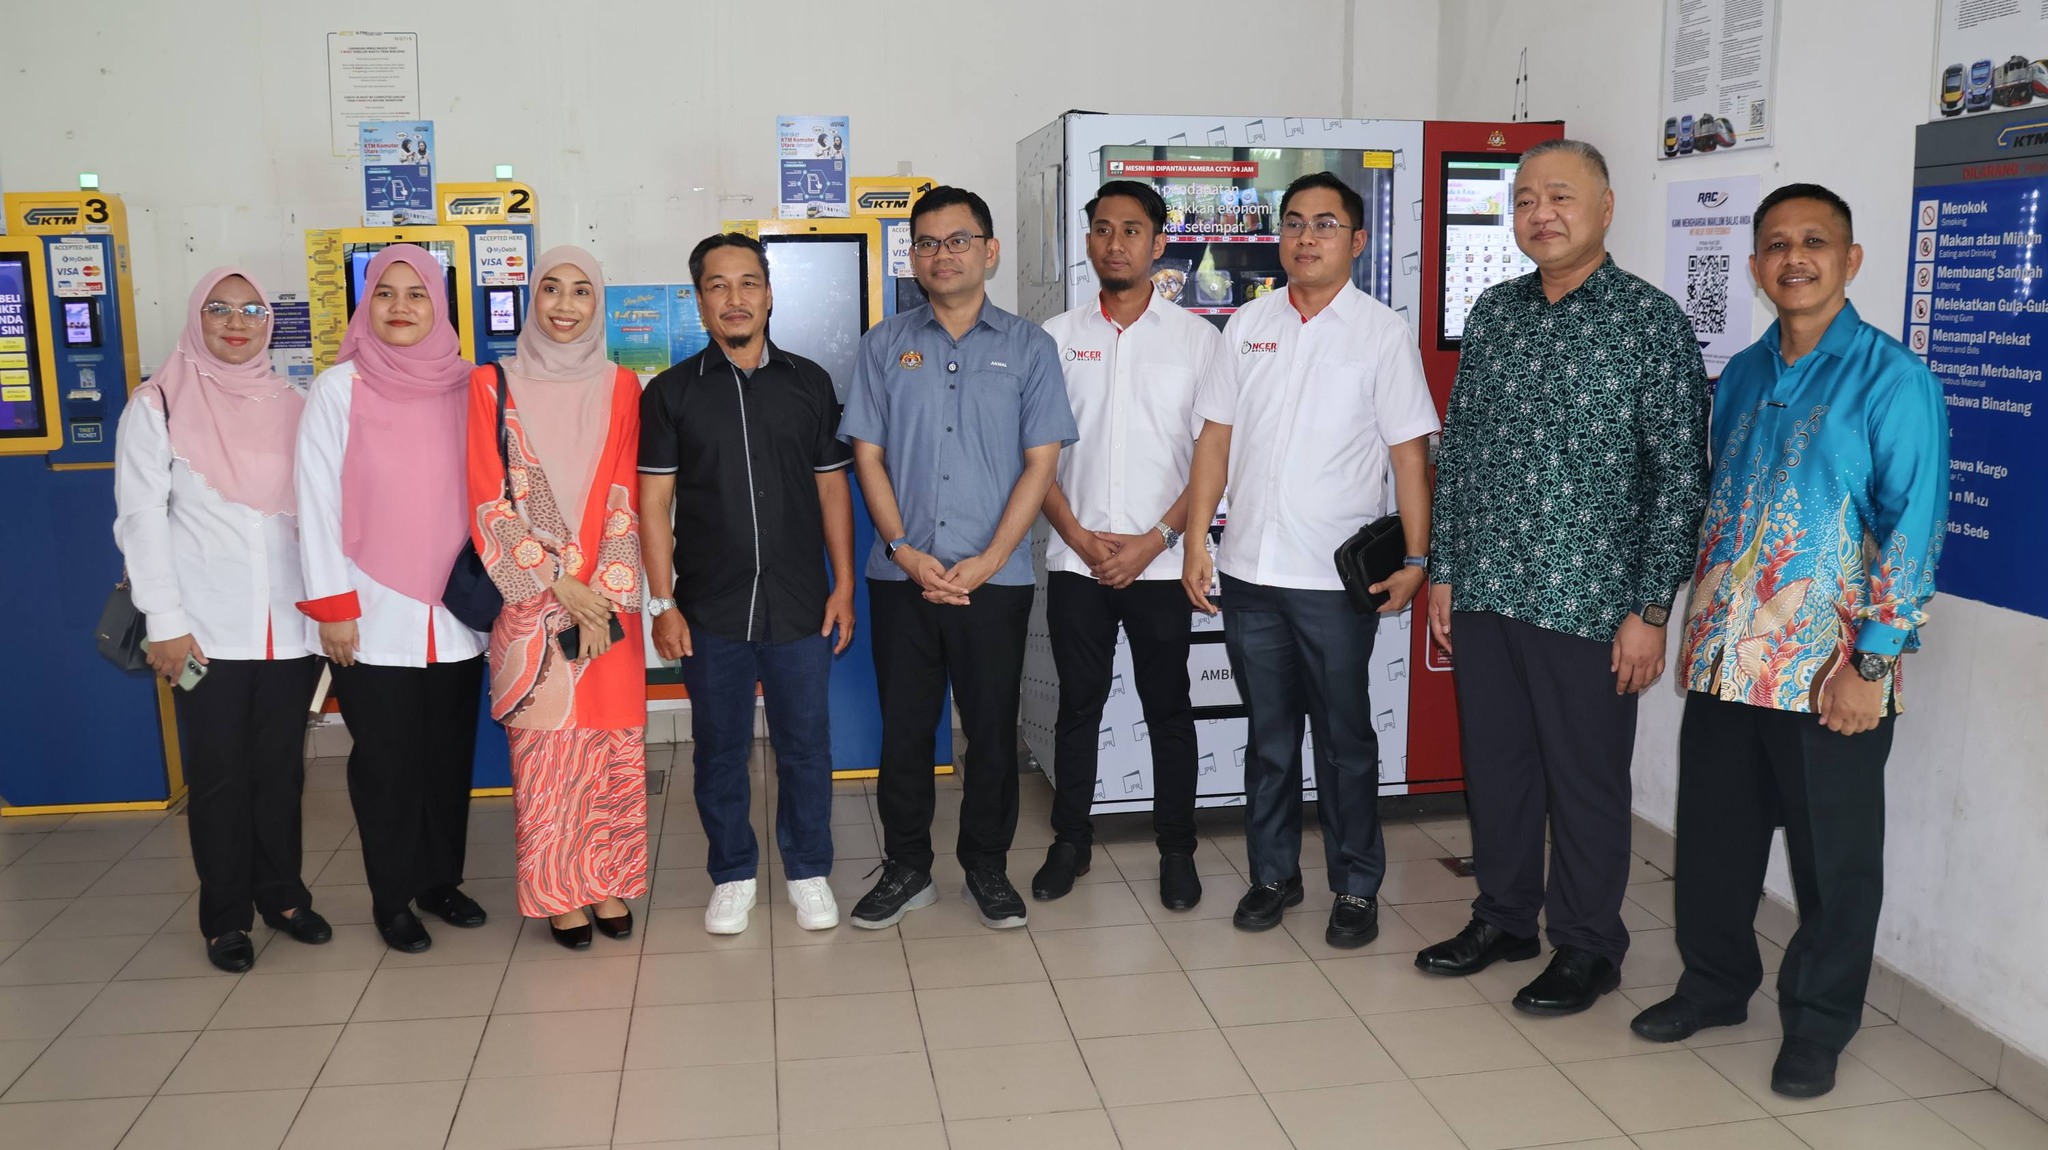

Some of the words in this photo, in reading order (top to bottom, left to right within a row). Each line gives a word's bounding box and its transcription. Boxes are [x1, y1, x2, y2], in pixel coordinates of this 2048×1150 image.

[2013, 132, 2048, 148] KTM
[1962, 162, 2019, 180] DILARANG
[1163, 183, 1239, 197] pendapatan
[508, 189, 531, 213] 2
[1698, 192, 1719, 203] RAC
[41, 217, 77, 225] KTM
[85, 199, 109, 223] 3
[1166, 203, 1215, 214] erakkan
[1218, 203, 1272, 214] ekonomi
[1942, 201, 1988, 215] Merokok
[1162, 222, 1183, 232] kat
[1185, 222, 1247, 236] setempat.
[1672, 219, 1681, 227] KAMI
[1941, 218, 1967, 227] Smoking
[1940, 234, 1974, 246] Makan
[1976, 234, 2000, 245] atau
[2003, 232, 2042, 245] Minum
[1939, 250, 1958, 259] Eating
[1970, 249, 1996, 259] Drinking
[1937, 266, 1995, 281] Membuang
[1997, 265, 2042, 280] Sampah
[1936, 282, 1960, 291] Littering
[0, 304, 22, 313] IKET
[1934, 297, 1995, 311] Melekatkan
[1998, 299, 2048, 313] Gula-Gula
[0, 315, 23, 324] NDA
[1934, 313, 1958, 323] Chewing
[1960, 314, 1974, 322] Gum
[1, 325, 24, 334] SINI
[1933, 329, 1986, 345] Menampal
[1988, 331, 2030, 346] Pelekat
[1932, 344, 1953, 353] Posters
[1954, 345, 1965, 353] and
[1967, 345, 1980, 354] Bills
[1930, 360, 1978, 377] Barangan
[1981, 364, 2042, 382] Merbahaya
[1961, 378, 1986, 388] Material
[1944, 394, 1979, 408] mbawa
[1982, 396, 2032, 417] Binatang
[1976, 461, 2008, 479] Kargo
[1963, 523, 1989, 539] Sede
